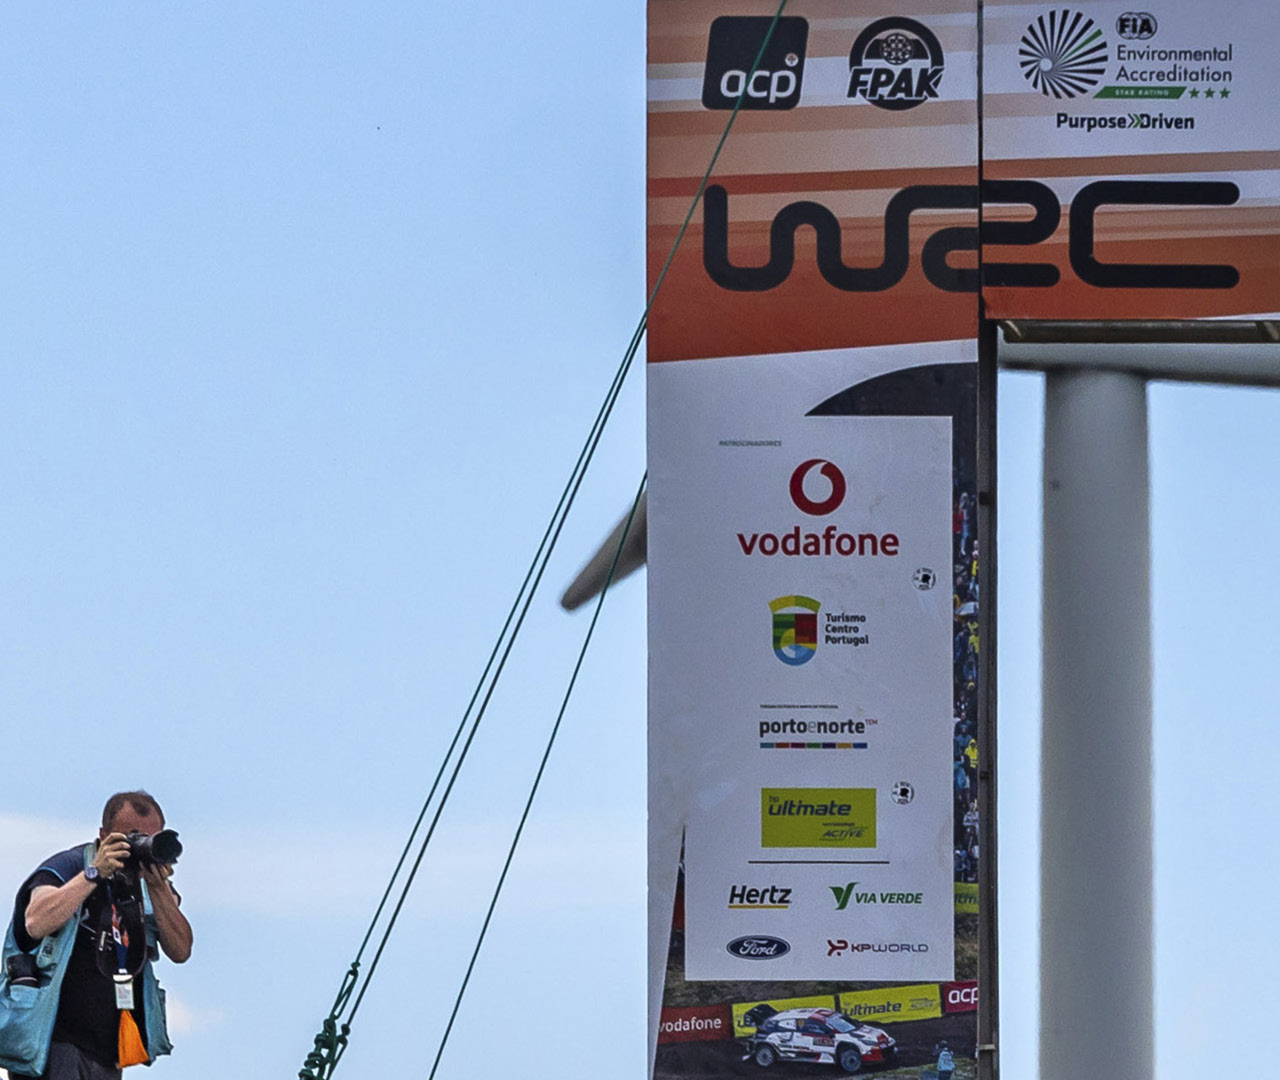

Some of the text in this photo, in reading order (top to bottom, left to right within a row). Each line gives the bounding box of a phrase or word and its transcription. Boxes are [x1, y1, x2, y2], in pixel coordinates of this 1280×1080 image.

[1117, 15, 1156, 36] FIA
[1117, 44, 1233, 62] Environmental
[1115, 64, 1233, 82] Accreditation
[720, 67, 797, 103] acp
[846, 66, 943, 100] FPAK
[1056, 113, 1195, 132] Purpose Driven
[703, 180, 1240, 292] WRC
[737, 526, 900, 556] vodafone
[825, 613, 867, 623] Turismo
[825, 624, 860, 634] Centro
[825, 635, 869, 647] Portugal
[759, 719, 866, 738] portoenorte
[768, 800, 852, 816] ultimate
[729, 885, 792, 904] Hertz
[855, 893, 923, 904] VIA VERDE
[739, 940, 777, 956] Ford
